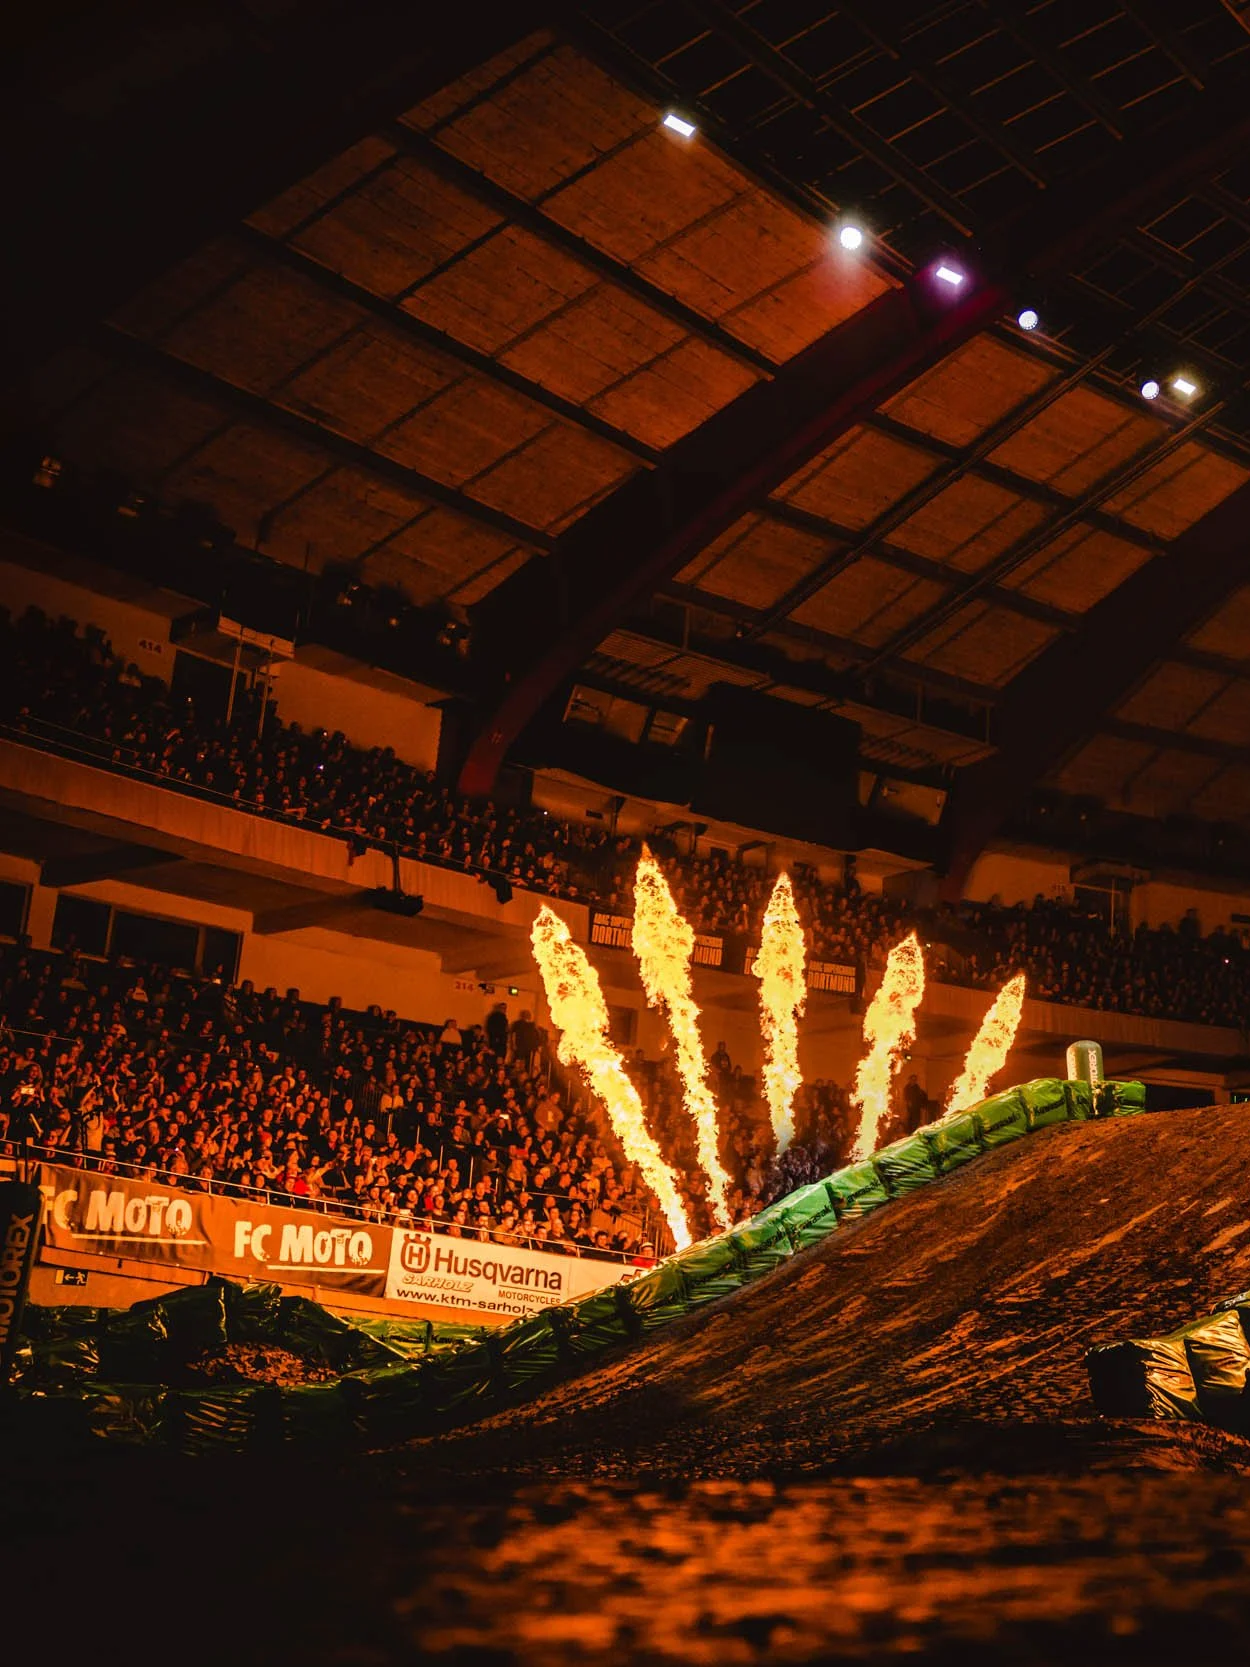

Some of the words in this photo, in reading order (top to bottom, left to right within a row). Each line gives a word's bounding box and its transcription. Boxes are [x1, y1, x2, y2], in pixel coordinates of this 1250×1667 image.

[38, 1185, 78, 1230] FC
[234, 1221, 272, 1262] FC
[402, 1273, 474, 1293] SARHOLZ
[434, 1247, 562, 1291] Husqvarna
[498, 1290, 561, 1305] MOTORCYCLES
